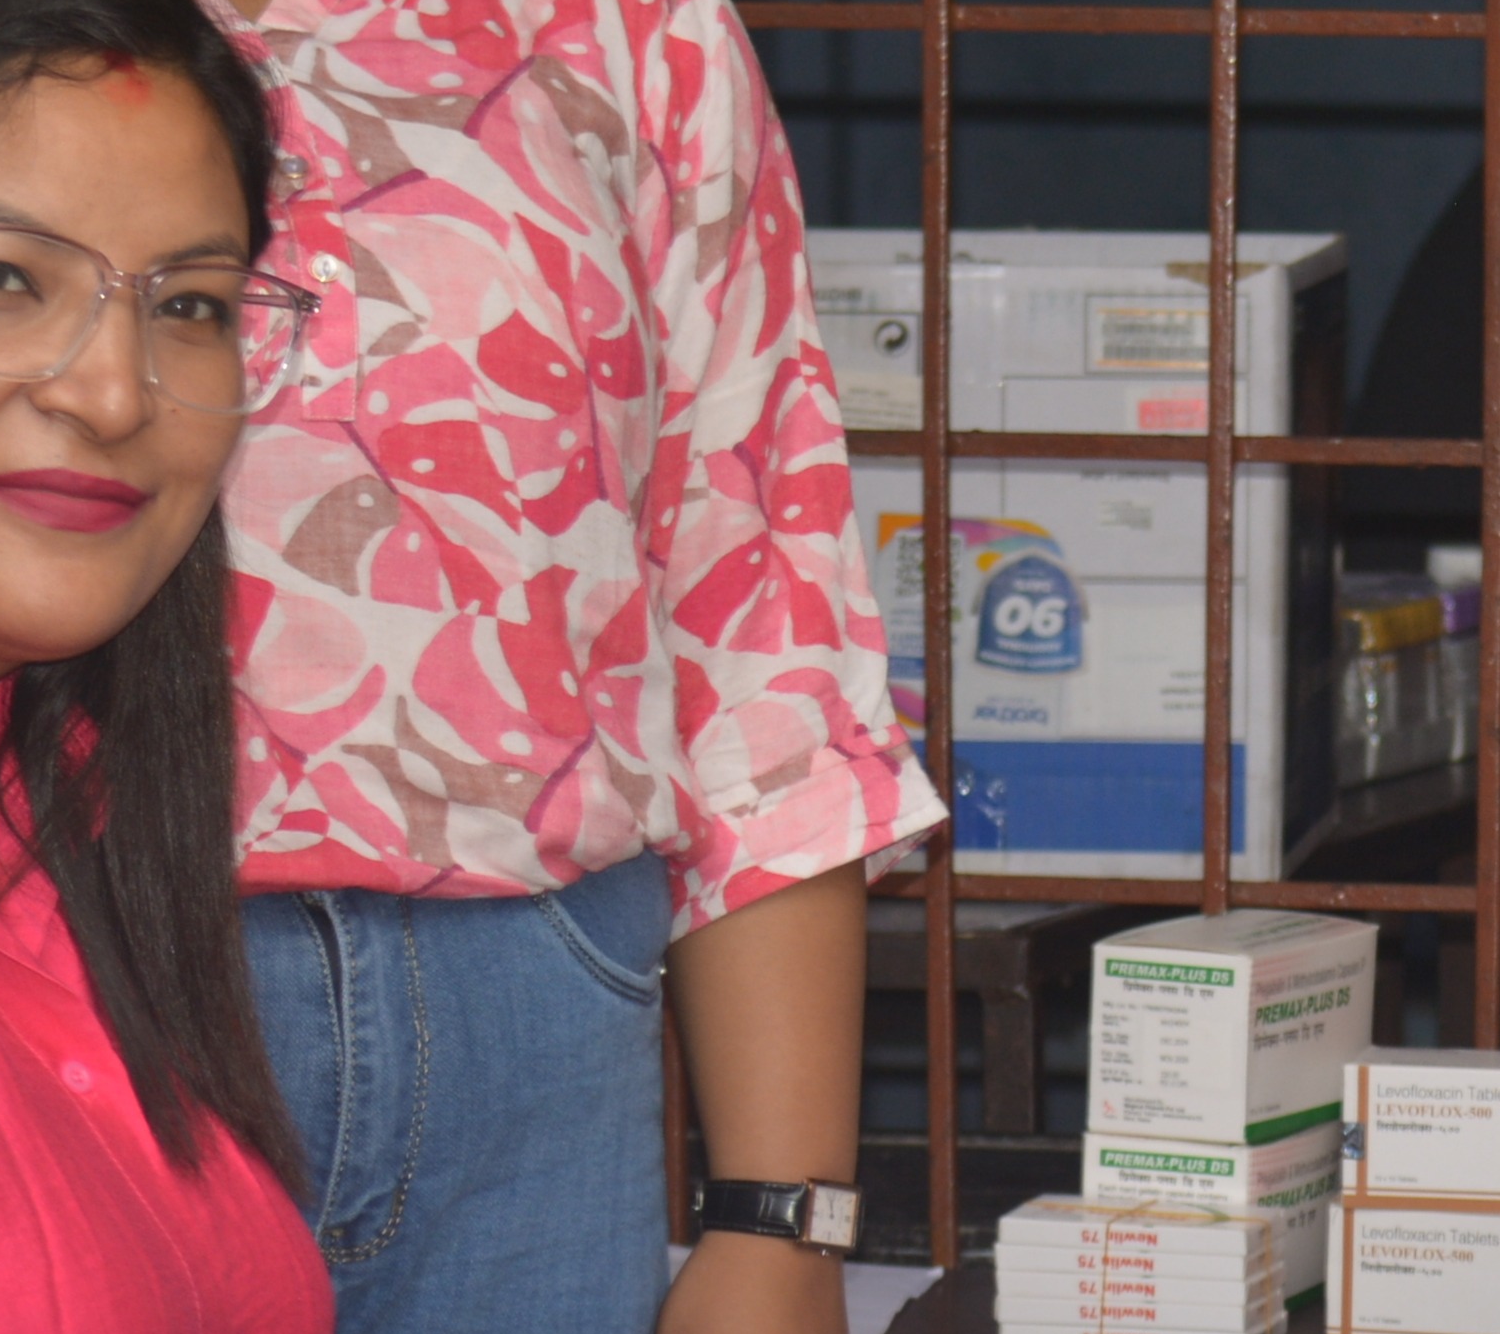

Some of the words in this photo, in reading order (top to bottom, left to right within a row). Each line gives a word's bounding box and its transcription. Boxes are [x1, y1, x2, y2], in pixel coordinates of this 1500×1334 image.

[993, 594, 1067, 638] 90
[972, 703, 1049, 726] brother
[1108, 961, 1208, 984] PREMAX-PLUS
[1210, 970, 1231, 985] DS
[1254, 989, 1335, 1028] PREMAX-PLUS
[1336, 986, 1352, 1008] DS
[1376, 1084, 1464, 1101] Levofloxacin
[1375, 1104, 1493, 1120] LEVOFLOX-500
[1104, 1152, 1207, 1172] PREMAX-PLUS
[1210, 1160, 1231, 1174] DS
[1081, 1230, 1099, 1242] 75
[1361, 1225, 1447, 1244] Levofloxacin
[1450, 1228, 1500, 1247] Tablets
[1077, 1255, 1096, 1268] 75
[1360, 1245, 1474, 1264] LEVOFLOX-500
[1078, 1281, 1097, 1294] 75
[1079, 1306, 1098, 1319] 75
